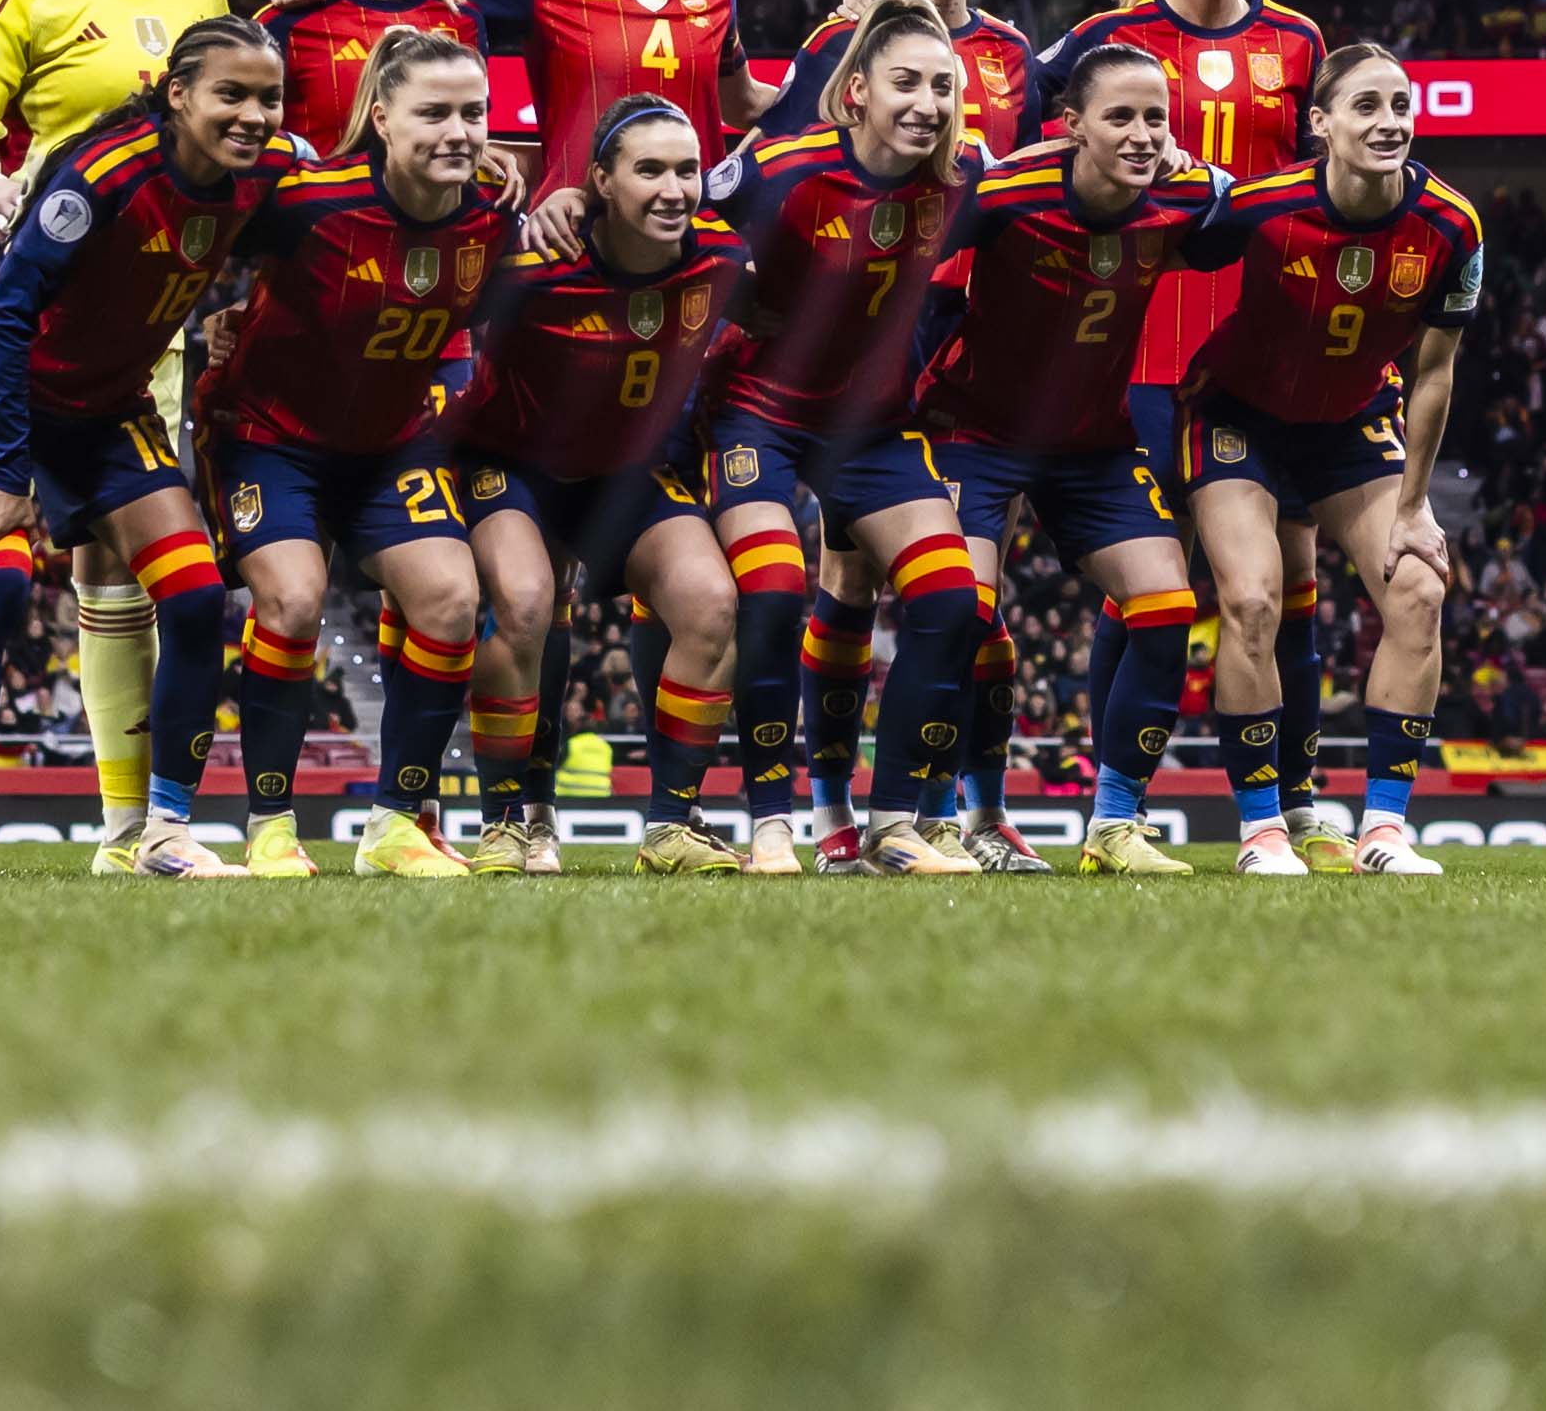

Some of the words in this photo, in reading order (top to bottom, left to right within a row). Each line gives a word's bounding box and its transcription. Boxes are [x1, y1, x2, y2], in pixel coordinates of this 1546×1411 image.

[641, 18, 679, 79] 4
[1201, 100, 1235, 165] 11
[148, 270, 209, 325] 18
[866, 261, 897, 316] 7
[1076, 289, 1117, 342] 2
[364, 307, 450, 360] 20
[1326, 305, 1365, 356] 9
[620, 350, 659, 407] 8
[901, 430, 941, 480] 7
[396, 468, 466, 524] 20
[1133, 466, 1174, 520] 2
